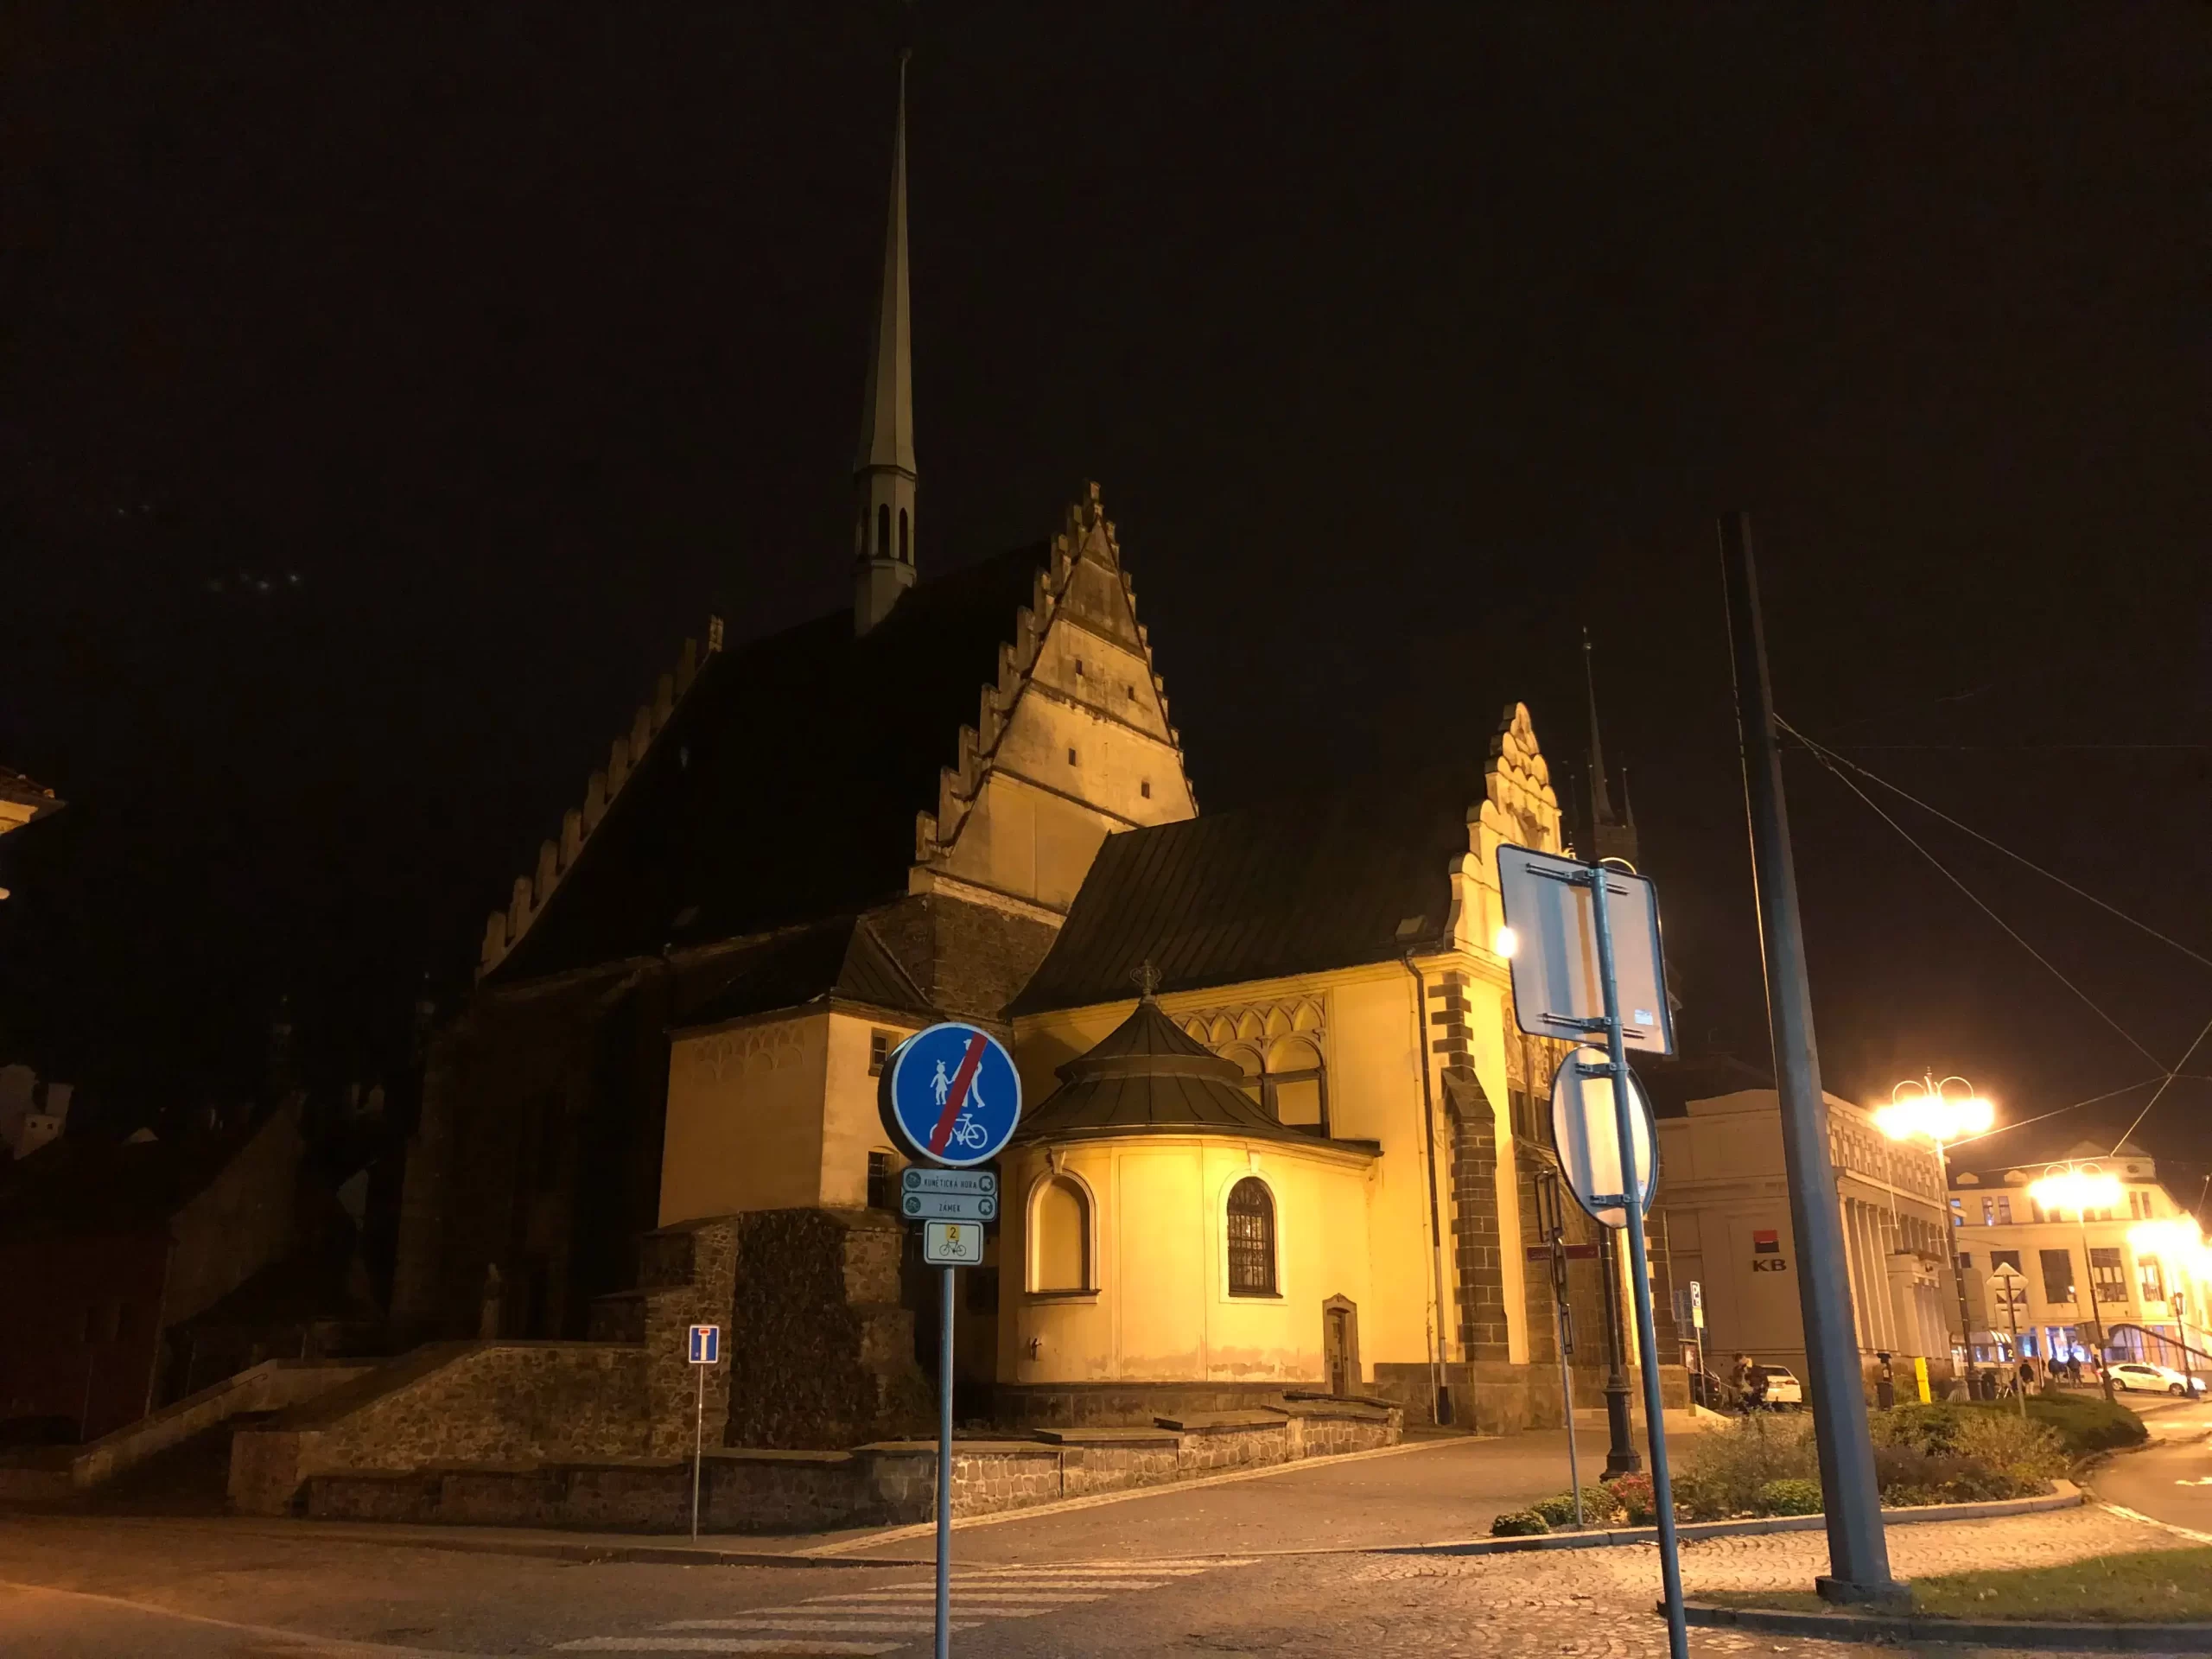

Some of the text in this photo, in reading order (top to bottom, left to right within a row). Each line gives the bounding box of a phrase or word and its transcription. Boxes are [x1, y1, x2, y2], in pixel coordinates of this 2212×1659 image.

[924, 1176, 958, 1189] KUNĚTICKÁ
[938, 1200, 961, 1212] ZÁMEK
[950, 1227, 957, 1239] 2
[1752, 1259, 1787, 1272] KB
